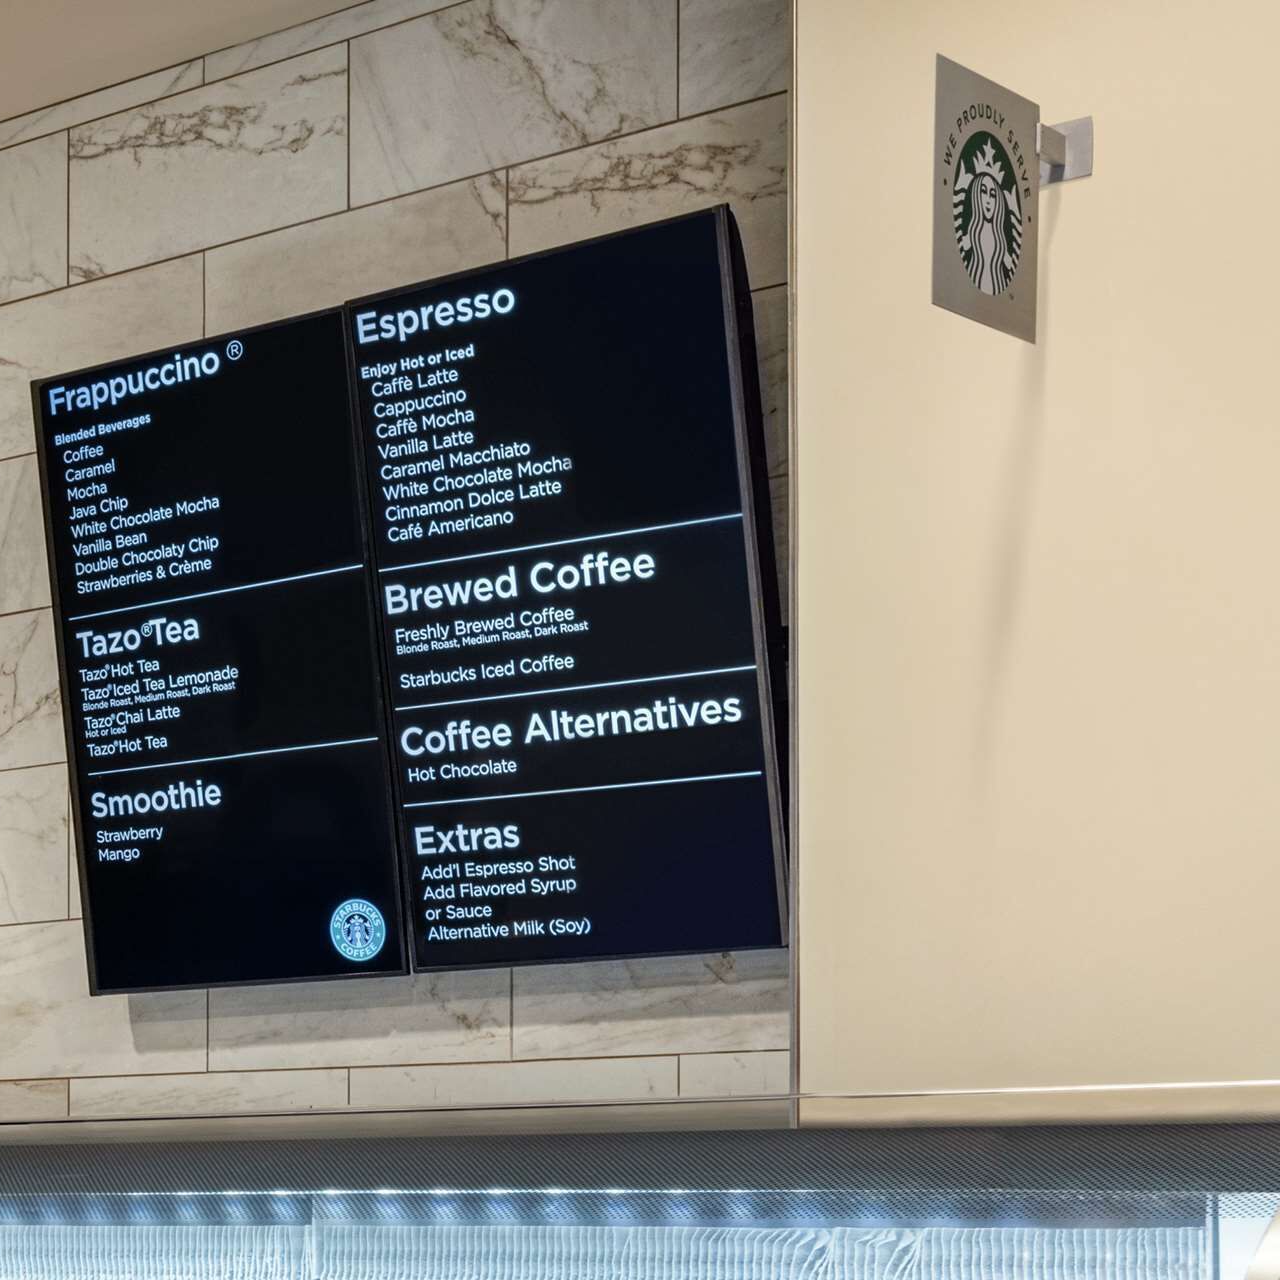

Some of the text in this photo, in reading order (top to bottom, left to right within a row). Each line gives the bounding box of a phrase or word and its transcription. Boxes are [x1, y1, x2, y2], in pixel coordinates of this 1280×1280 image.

[944, 103, 1031, 199] WE PROUDLY SERVE
[356, 288, 515, 344] Espresso
[361, 344, 474, 380] Enjoy Hot or Iced
[371, 368, 458, 398] Caffè Latte
[374, 389, 466, 418] Cappuccino
[55, 414, 151, 446] Blended Beverages
[376, 408, 474, 439] Caffè Mocha
[63, 445, 103, 464] Coffee
[378, 431, 473, 460] Vanilla Latte
[65, 460, 115, 482] Caramel
[380, 441, 531, 481] Caramel Macchiato
[68, 482, 107, 501] Mocha
[383, 456, 572, 501] White Chocolate Mocha
[69, 497, 128, 521] Java Chip
[385, 479, 562, 522] Cinnamon Dolce Latte
[71, 496, 219, 539] White Chocolate Mocha
[388, 509, 514, 542] Café Americano
[73, 531, 147, 557] Vanilla Bean
[75, 536, 218, 576] Double Chocolaty Chip
[77, 558, 212, 595] Strawberries & Crème
[385, 552, 656, 615] Brewed Coffee
[395, 606, 574, 644] Freshly Brewed Coffee
[396, 621, 588, 655] Blonde Roast, Medium Roast, Dark Roast
[137, 659, 159, 673] Tea
[143, 678, 165, 692] Tea
[169, 665, 239, 688] Lemonade
[400, 653, 574, 689] Starbucks Iced Coffee
[82, 681, 236, 711] Blonde Roast, Medium Roast, Dark Roast
[147, 705, 180, 721] Latte
[400, 697, 743, 757] Coffee Alternatives
[85, 725, 126, 739] Hot or Iced
[145, 736, 167, 748] Tea
[408, 758, 517, 783] Hot Chocolate
[91, 779, 222, 819] Smoothie
[96, 826, 163, 844] Strawberry
[414, 823, 520, 855] Extras
[98, 847, 140, 863] Mango
[465, 860, 534, 878] Espresso
[538, 855, 576, 872] Shot
[424, 877, 577, 900] Add Flavored Syrup
[333, 902, 381, 928] STARBUCKS
[425, 904, 492, 921] or Sauce
[428, 917, 591, 941] Alternative Milk (Soy)
[340, 943, 377, 957] COFFEE
